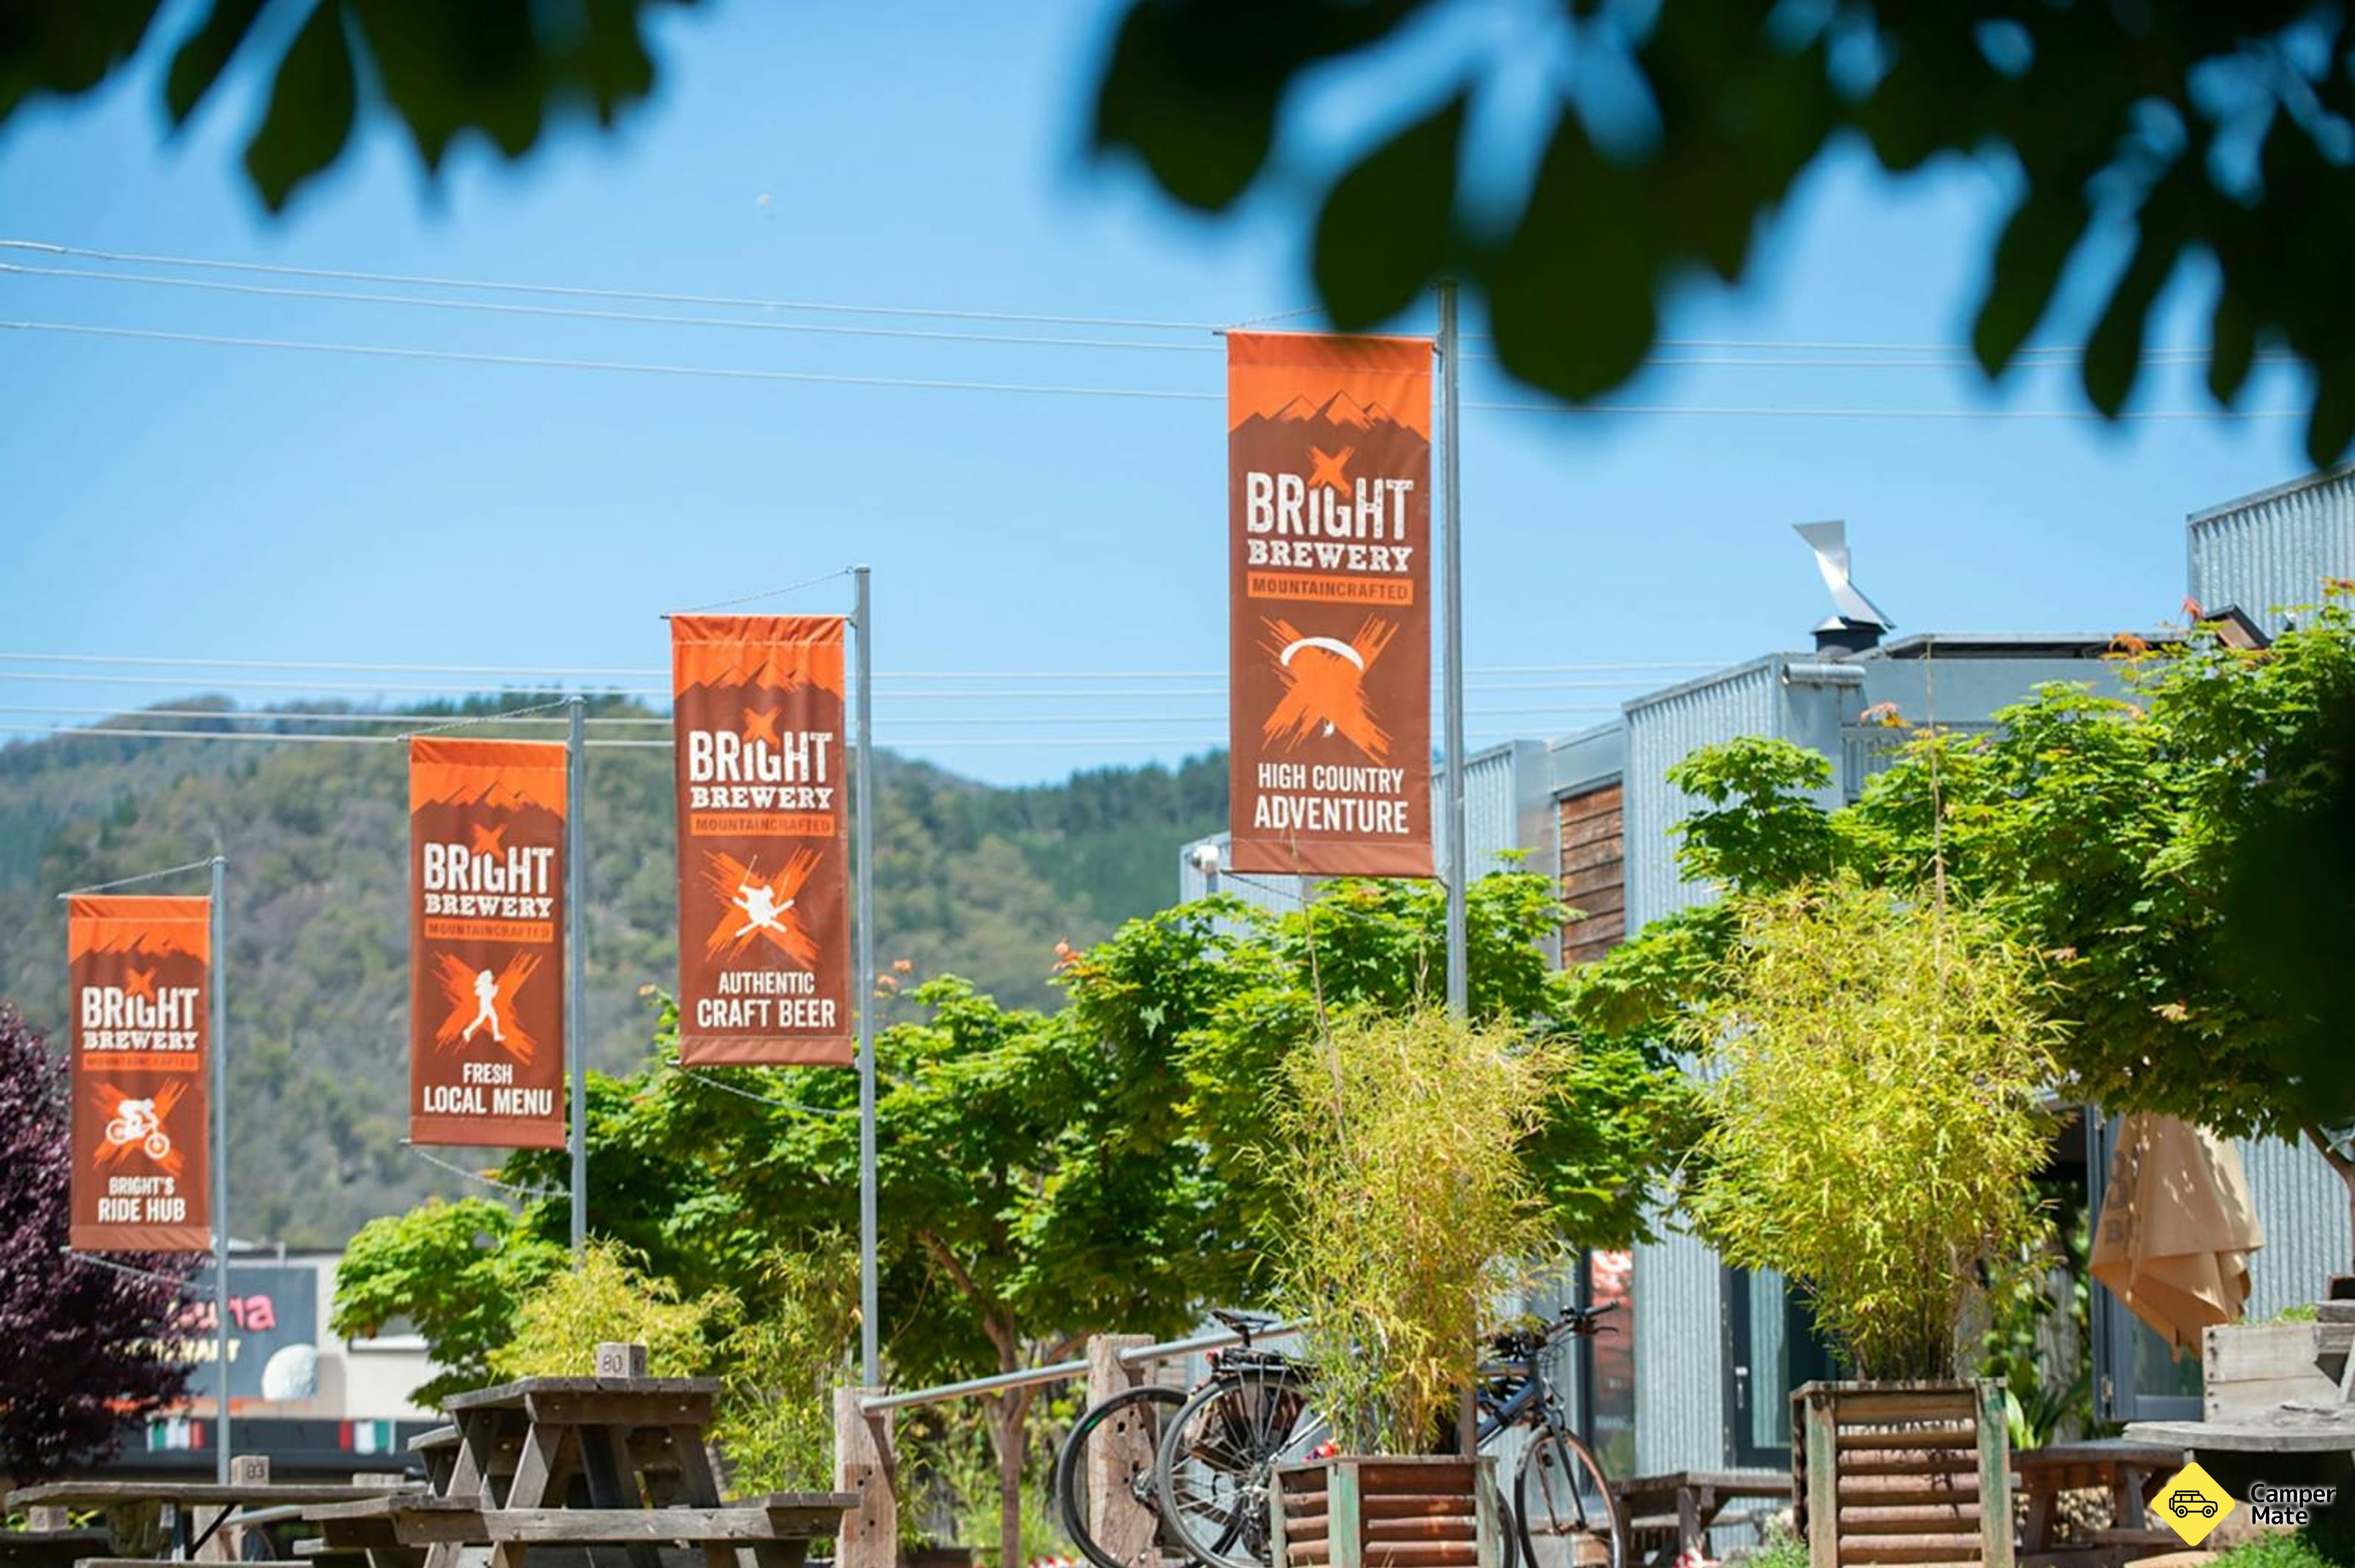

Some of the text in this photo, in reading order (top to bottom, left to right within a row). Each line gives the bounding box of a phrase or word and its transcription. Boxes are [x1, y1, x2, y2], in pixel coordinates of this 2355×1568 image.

[1248, 538, 1413, 572] BREWERY
[1252, 577, 1407, 600] MOUNTAINCRAFTED
[1258, 762, 1404, 794] HIGH COUNTRY
[690, 786, 834, 810] BREWERY
[1254, 795, 1409, 834] ADVENTURE
[424, 893, 554, 918] BREWERY
[718, 972, 815, 994] AUTHENTIC
[697, 998, 836, 1028] CRAFT BEER
[82, 1030, 199, 1051] BREWERY
[463, 1062, 513, 1084] FRESH
[423, 1085, 553, 1116] LOCAL MENU
[108, 1177, 175, 1196] BRIGHT'S
[98, 1197, 186, 1224] RIDE HUB
[602, 1353, 623, 1373] 80
